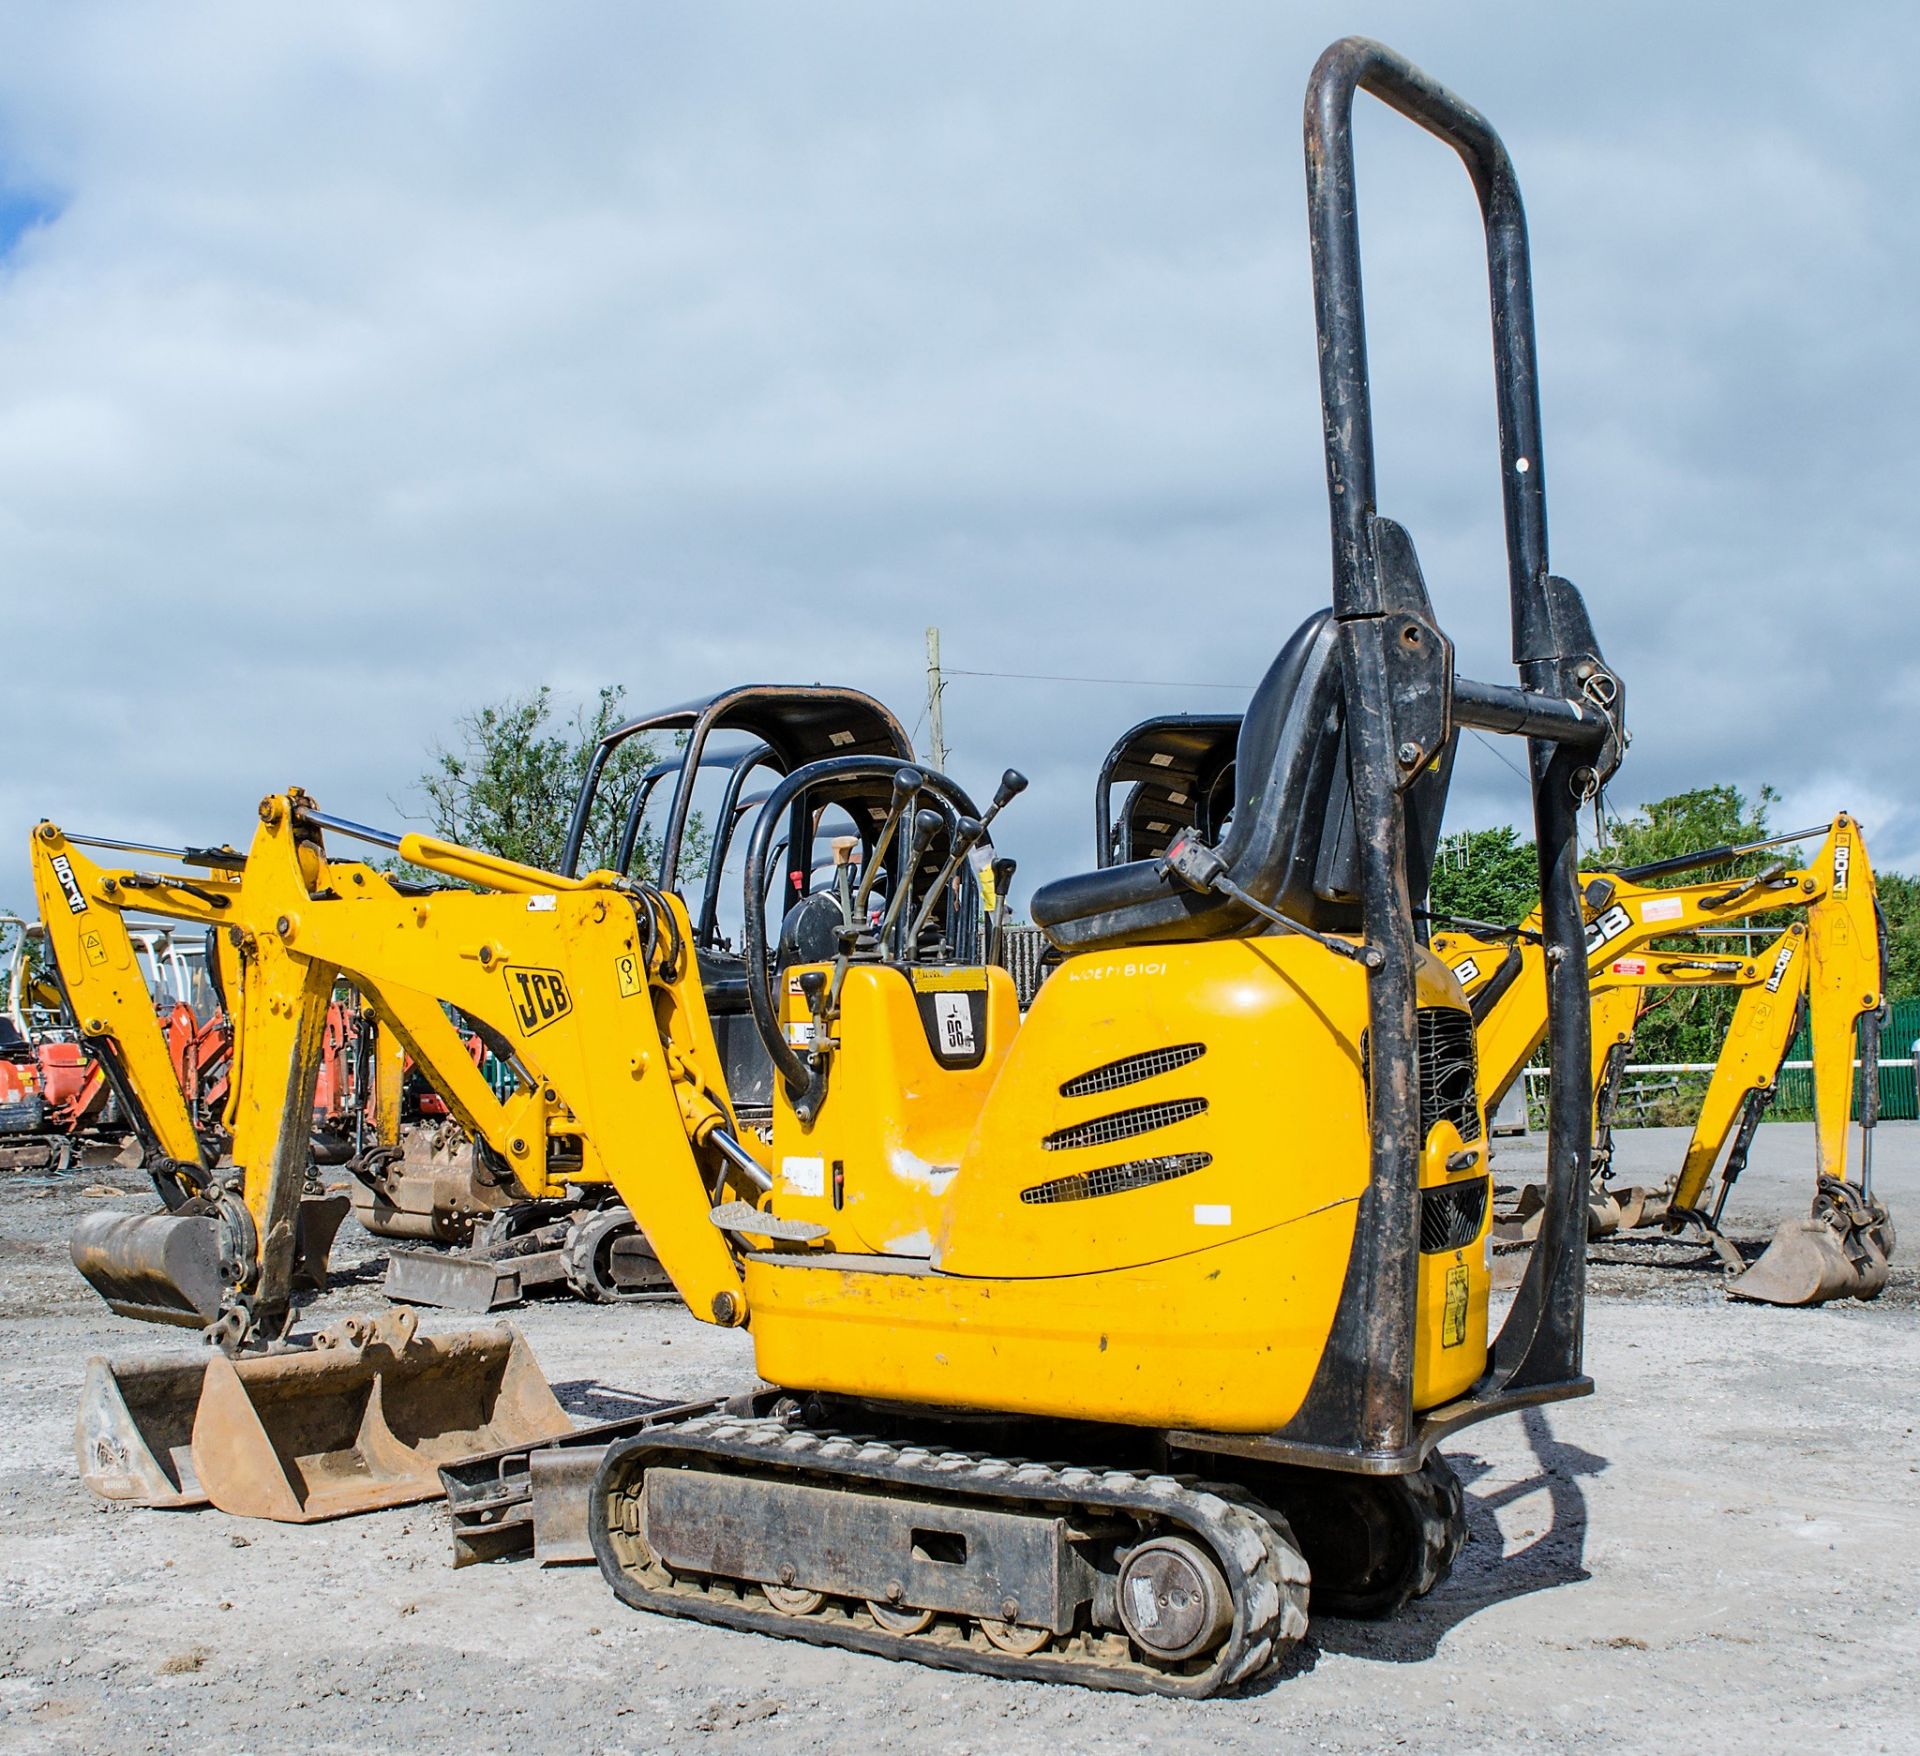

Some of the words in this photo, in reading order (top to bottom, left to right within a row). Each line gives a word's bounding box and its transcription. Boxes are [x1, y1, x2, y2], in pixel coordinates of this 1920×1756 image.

[52, 856, 84, 906] 8014
[1833, 847, 1849, 893] 8014
[1584, 906, 1631, 954] CB
[1767, 948, 1793, 988] 8014
[515, 972, 567, 1028] JCB
